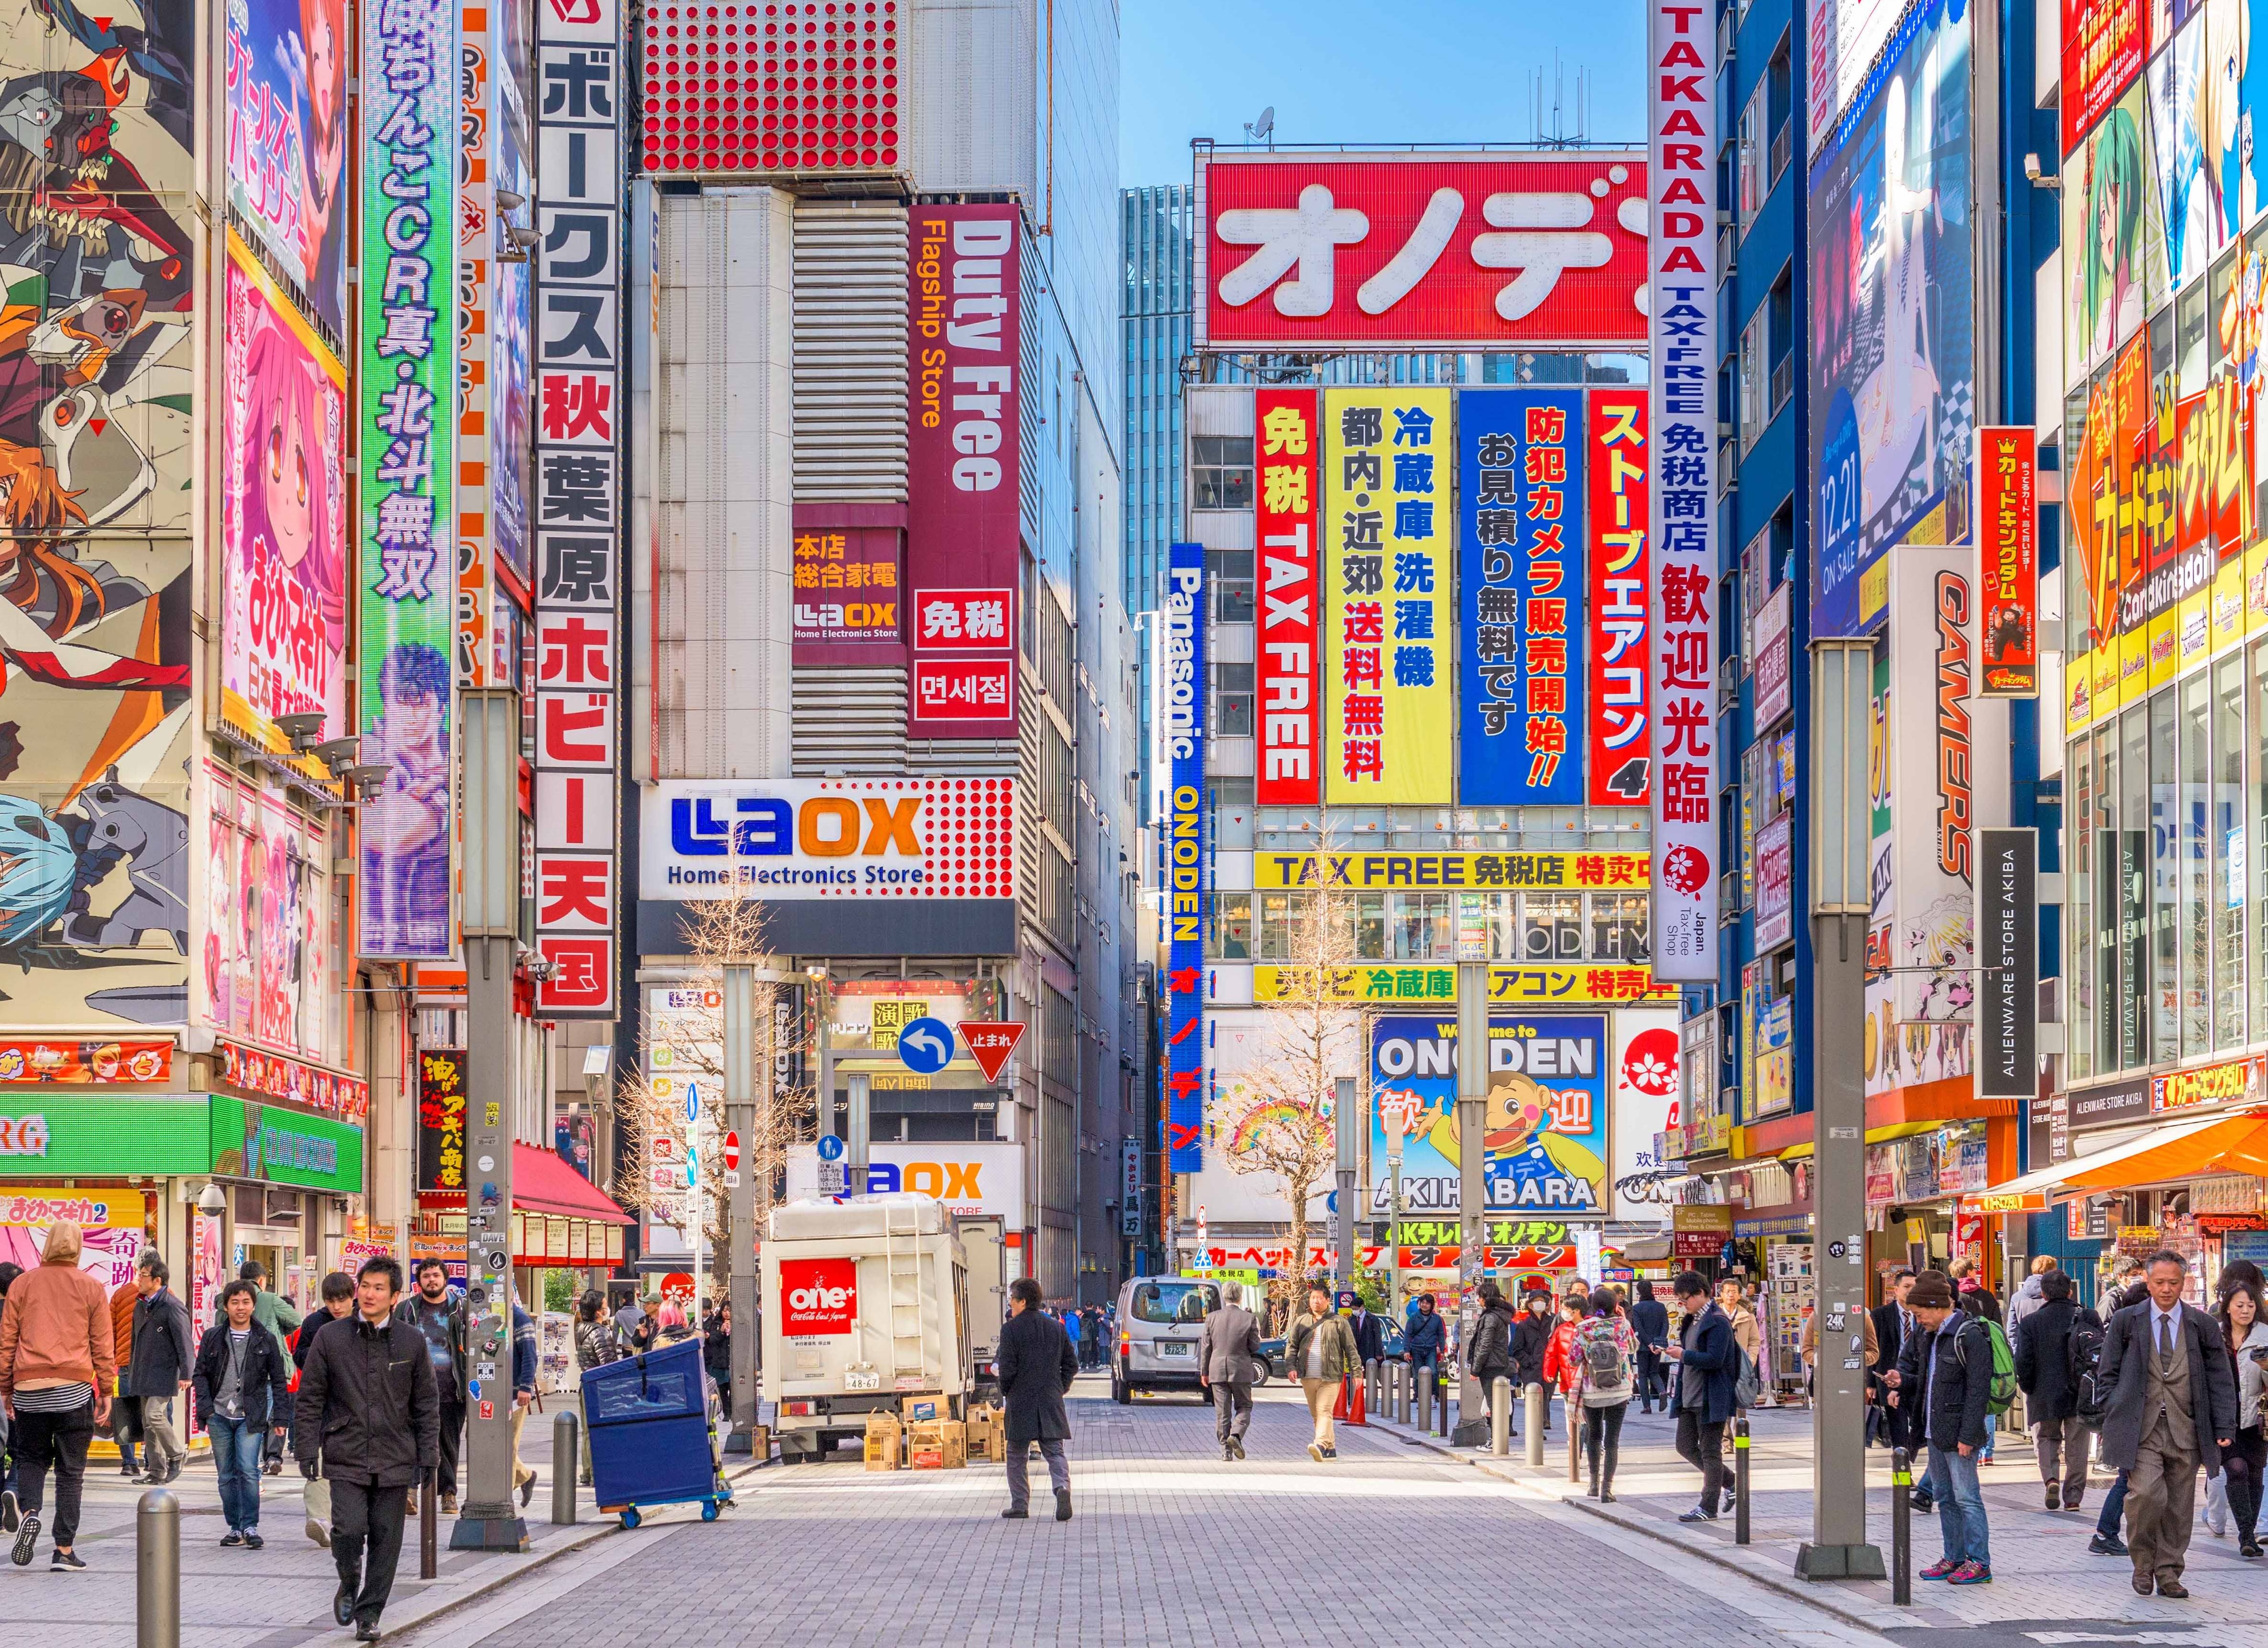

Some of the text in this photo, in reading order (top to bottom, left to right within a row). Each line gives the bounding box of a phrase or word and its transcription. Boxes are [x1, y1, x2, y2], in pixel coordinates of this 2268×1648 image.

[1659, 7, 1707, 273] TAKARADA
[916, 220, 946, 428] Flagship Store
[946, 220, 1012, 491] Duty Free
[1263, 407, 1309, 515] 免税
[1660, 423, 1709, 553] 免税商店
[1821, 451, 1856, 553] 12.21
[794, 534, 846, 560] 本店
[1996, 456, 2017, 600] カードキングダム
[794, 562, 897, 589] 総合家電
[1476, 432, 1518, 737] お見積り無料です
[1838, 542, 1855, 583] SALE
[794, 629, 898, 638] Home Electronics Store
[923, 600, 1004, 639] 免税
[1170, 566, 1202, 760] Panasonic
[1264, 523, 1311, 782] TAX FREE
[921, 674, 1006, 705] 면세점
[1661, 562, 1710, 824] 歓迎光臨
[1935, 569, 1973, 885] GAMERS
[672, 797, 923, 856] Laox
[668, 865, 923, 885] Home Electronics Store
[1173, 784, 1200, 942] ONODEN
[1364, 856, 1465, 886] FREE
[1474, 855, 1564, 886] 免税店
[1666, 924, 1678, 956] Shop
[1680, 907, 1691, 956] Tax-free
[1695, 912, 1705, 956] Japan.
[1366, 968, 1454, 998] 冷蔵庫
[1488, 971, 1576, 997] アコン
[2003, 850, 2015, 1077] ALIENWARE STORE AKIBA
[972, 1033, 1012, 1047] 止まれ
[1437, 1023, 1537, 1038] Weme to
[1170, 966, 1201, 1151] オノデン
[1549, 1090, 1592, 1135] 迎
[2076, 1091, 2143, 1115] ALIENWARE STORE AKIBA
[440, 1095, 466, 1187] アキバ商店
[1675, 1206, 1685, 1216] 2F
[482, 1233, 505, 1242] DAVE
[816, 1312, 830, 1320] East
[828, 1311, 847, 1322] Japan
[1826, 1314, 1844, 1327] 24K
[852, 1379, 877, 1388] 48-67
